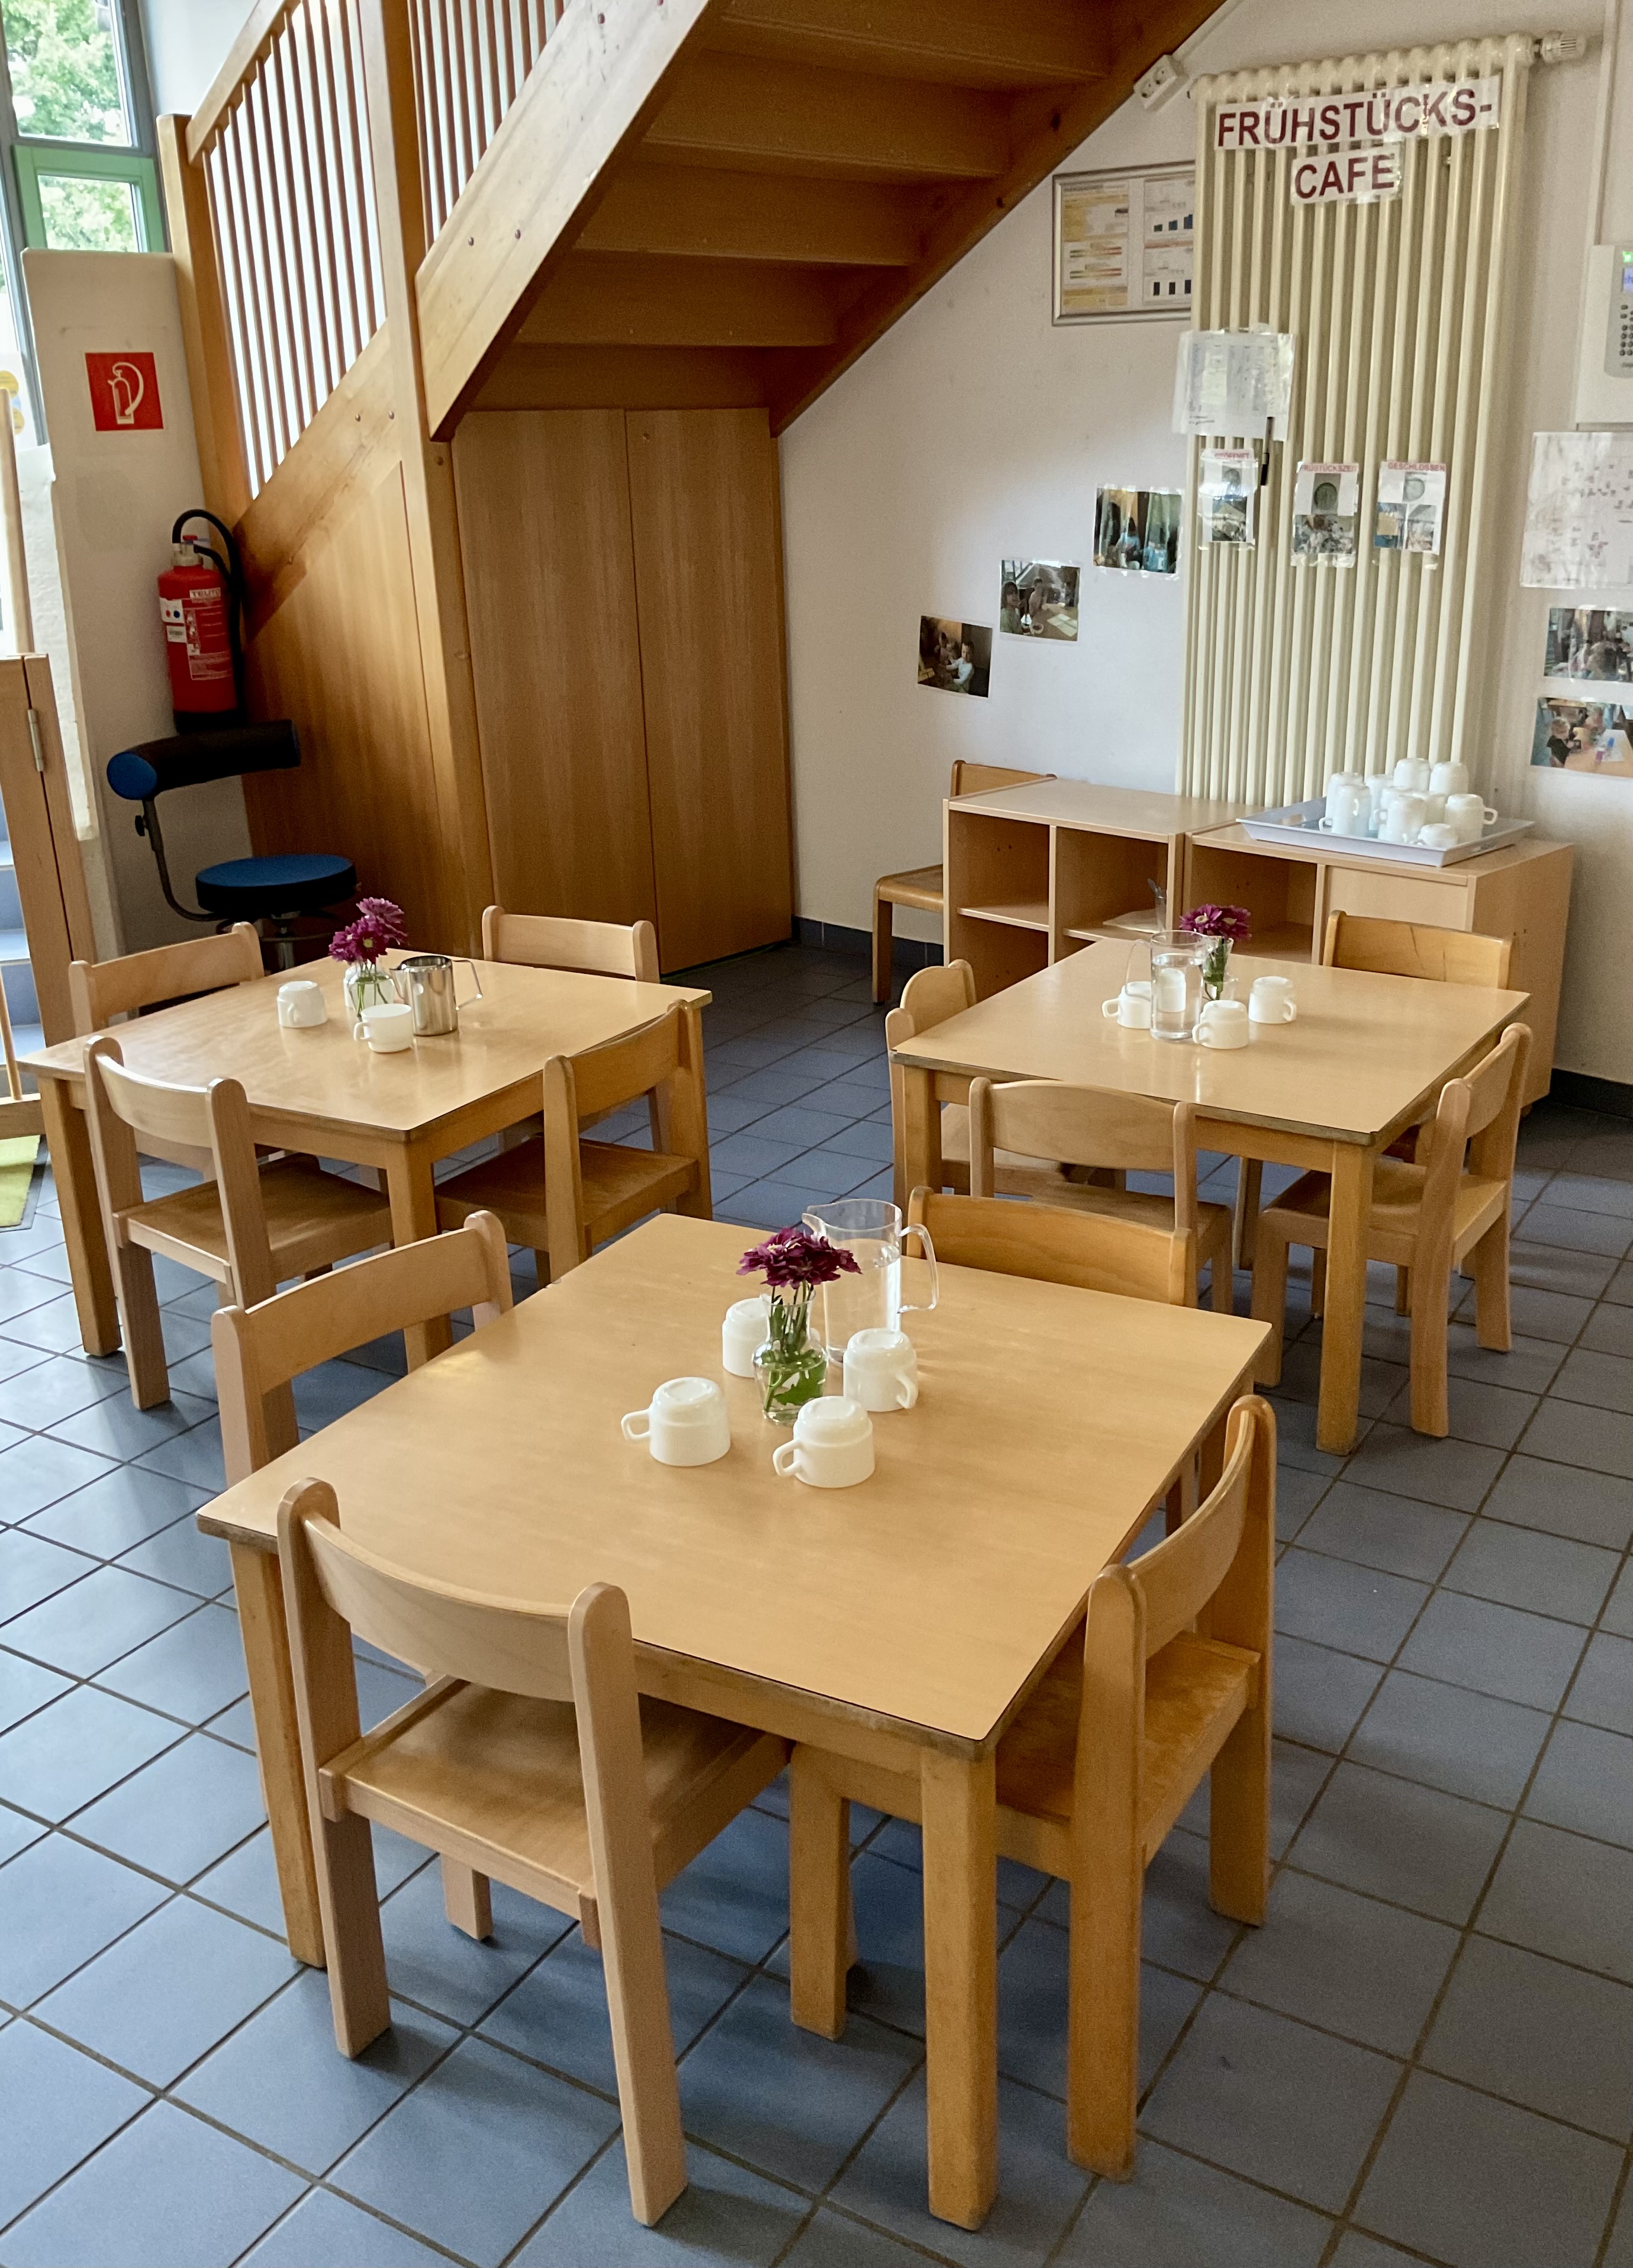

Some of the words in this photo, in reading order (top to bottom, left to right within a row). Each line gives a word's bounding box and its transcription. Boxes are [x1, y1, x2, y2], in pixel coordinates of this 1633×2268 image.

[1217, 88, 1493, 147] FRÜHSTÜCKS-
[1294, 154, 1396, 200] CAFE
[1387, 461, 1445, 471] GESCHLOSSEN
